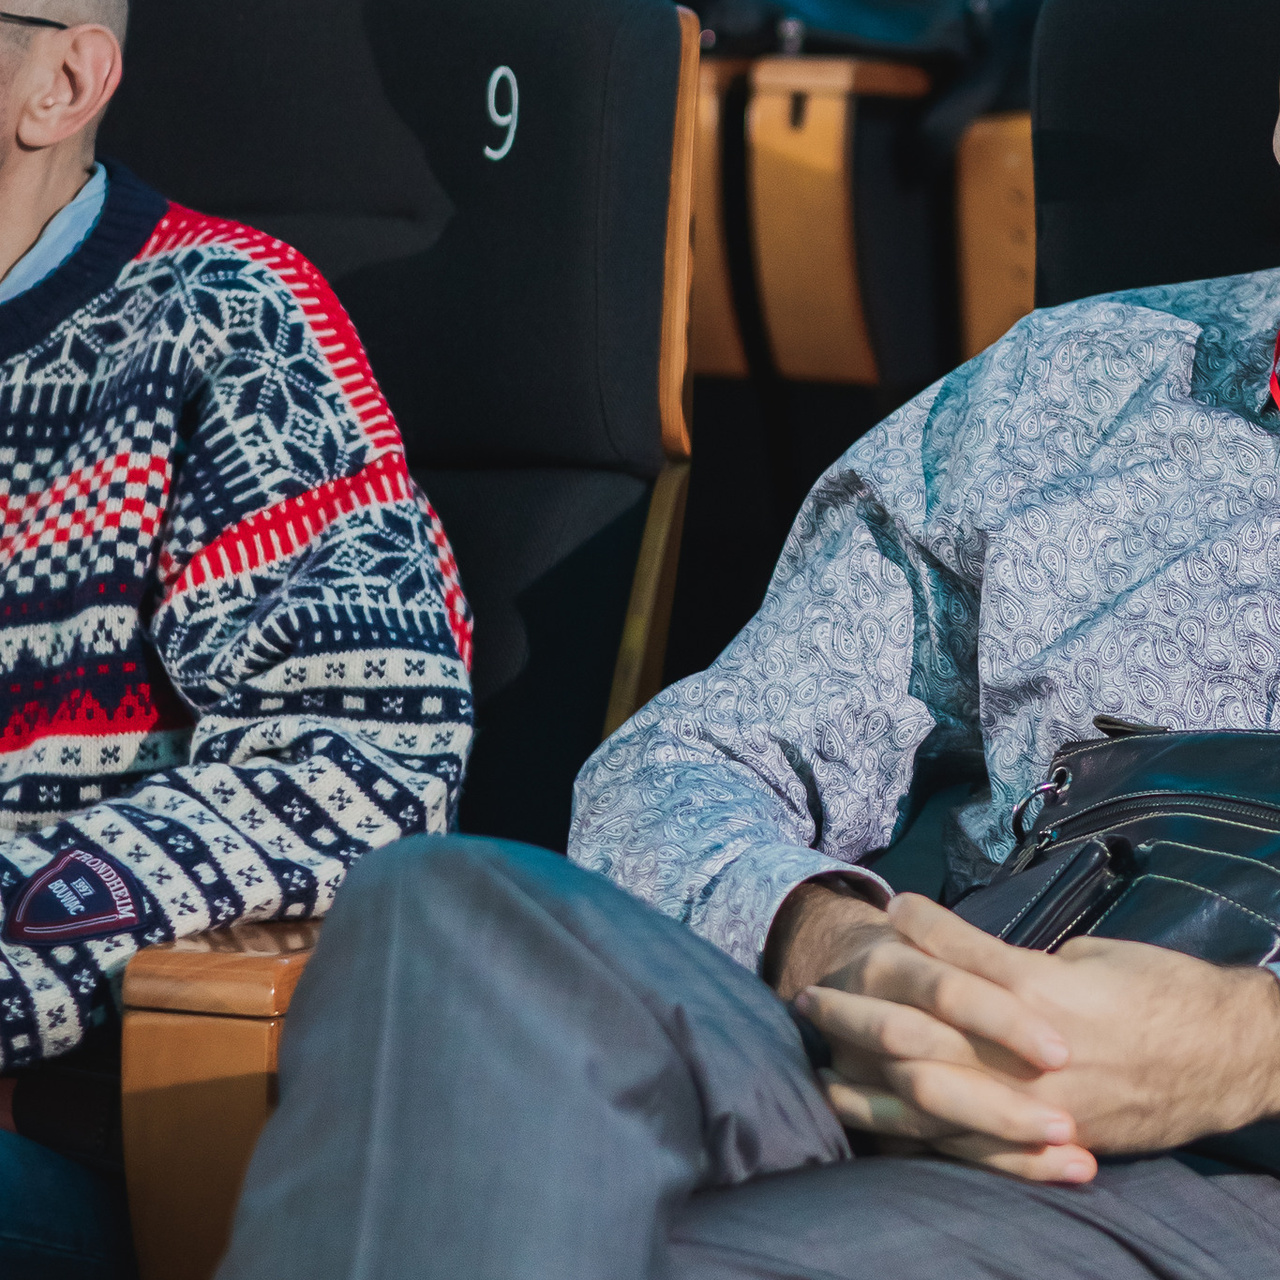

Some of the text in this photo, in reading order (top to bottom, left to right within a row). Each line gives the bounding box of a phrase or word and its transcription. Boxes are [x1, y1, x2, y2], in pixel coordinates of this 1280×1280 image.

[483, 64, 520, 162] 9
[69, 849, 137, 920] TRONDHEIM
[71, 877, 95, 897] 1997
